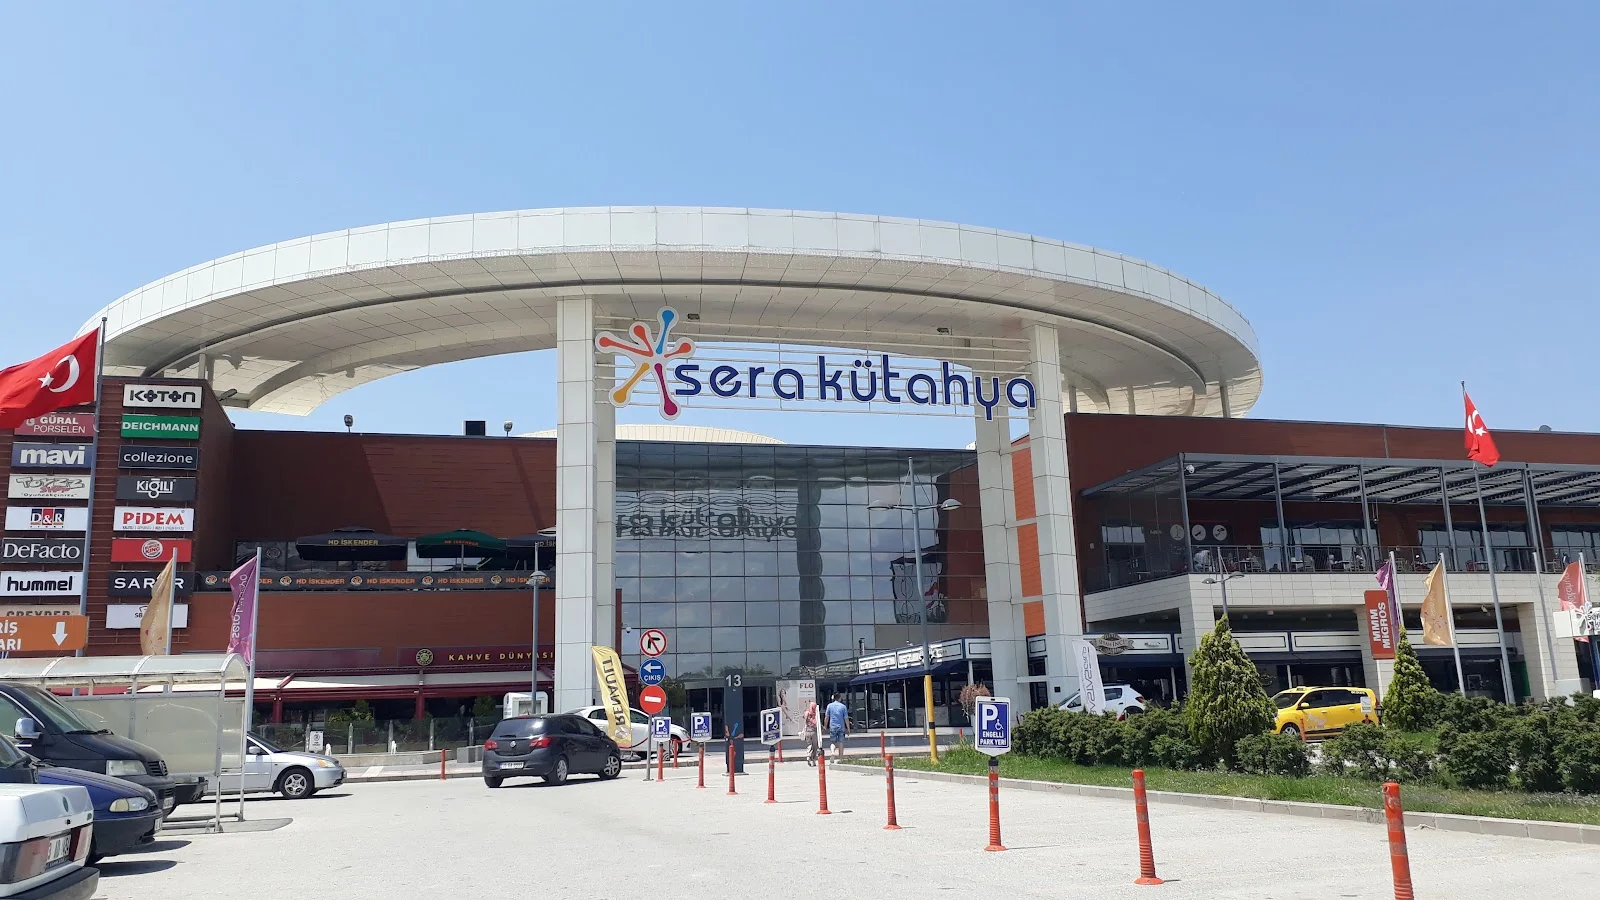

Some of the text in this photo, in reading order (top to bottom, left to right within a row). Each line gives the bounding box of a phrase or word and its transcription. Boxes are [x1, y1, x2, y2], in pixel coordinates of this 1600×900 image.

[674, 354, 1036, 421] sera kütahya
[129, 389, 196, 403] KOTON
[40, 414, 79, 425] GÜRAL
[33, 424, 86, 434] PORSELEN
[121, 421, 199, 432] DEICHMANN
[20, 445, 85, 465] mavi
[123, 451, 193, 464] collezione
[3, 543, 80, 559] DeFacto
[7, 575, 73, 592] hummel
[114, 577, 185, 589] SARR
[1369, 608, 1382, 642] MMM
[1377, 601, 1392, 649] MIGROS
[448, 651, 554, 661] KAHVE DÜNYSI
[643, 674, 661, 682] ÇIKIŞ
[725, 674, 742, 687] 13
[694, 716, 704, 730] P
[765, 713, 775, 732] P
[981, 704, 998, 730] P
[655, 719, 665, 732] P
[982, 730, 1004, 738] ENGELLİ
[994, 737, 1007, 746] YERİ
